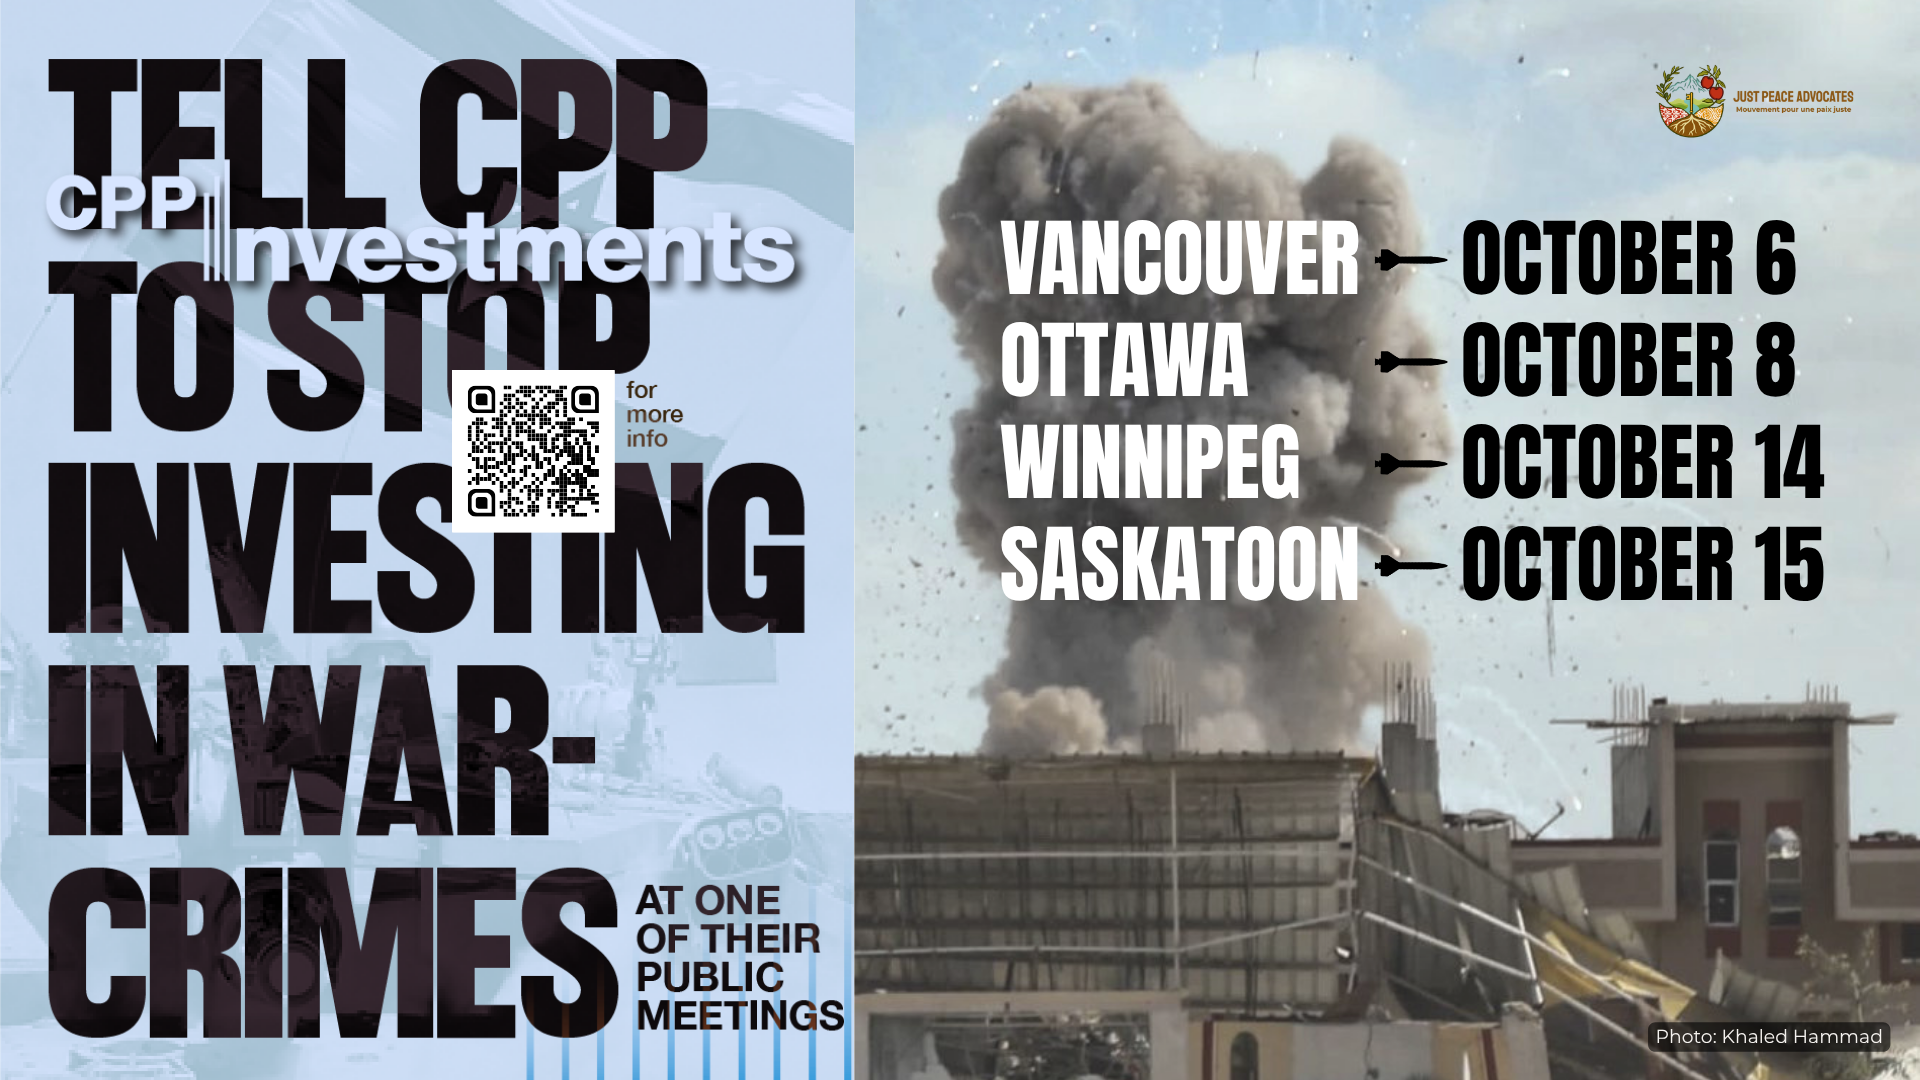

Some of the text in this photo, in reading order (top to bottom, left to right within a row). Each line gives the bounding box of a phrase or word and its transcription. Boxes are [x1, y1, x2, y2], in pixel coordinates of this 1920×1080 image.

[1733, 90, 1853, 102] JUST PEACE ADVOCATES
[1781, 107, 1798, 115] pour
[1816, 106, 1831, 115] paix
[1832, 106, 1851, 115] juste
[48, 58, 708, 230] TELL CPP
[45, 174, 196, 231] CPP
[1001, 219, 1797, 296] VANCOUVER OCTOBER 6
[48, 260, 235, 432] TO
[1001, 321, 1797, 398] OTTAWA OCTOBER 8
[626, 380, 658, 399] for
[626, 408, 683, 424] more
[626, 429, 668, 448] info
[1001, 423, 1825, 500] WINNIPEG OCTOBER 14
[1001, 525, 1825, 602] SASKATOON OCTOBER 15
[48, 664, 596, 836] IN WAR-
[635, 884, 781, 916] AT ONE
[48, 867, 619, 1039] CRIMES
[636, 922, 821, 954] OF THEIR
[637, 961, 784, 993] PUBLIC
[637, 999, 845, 1031] MEETINGS
